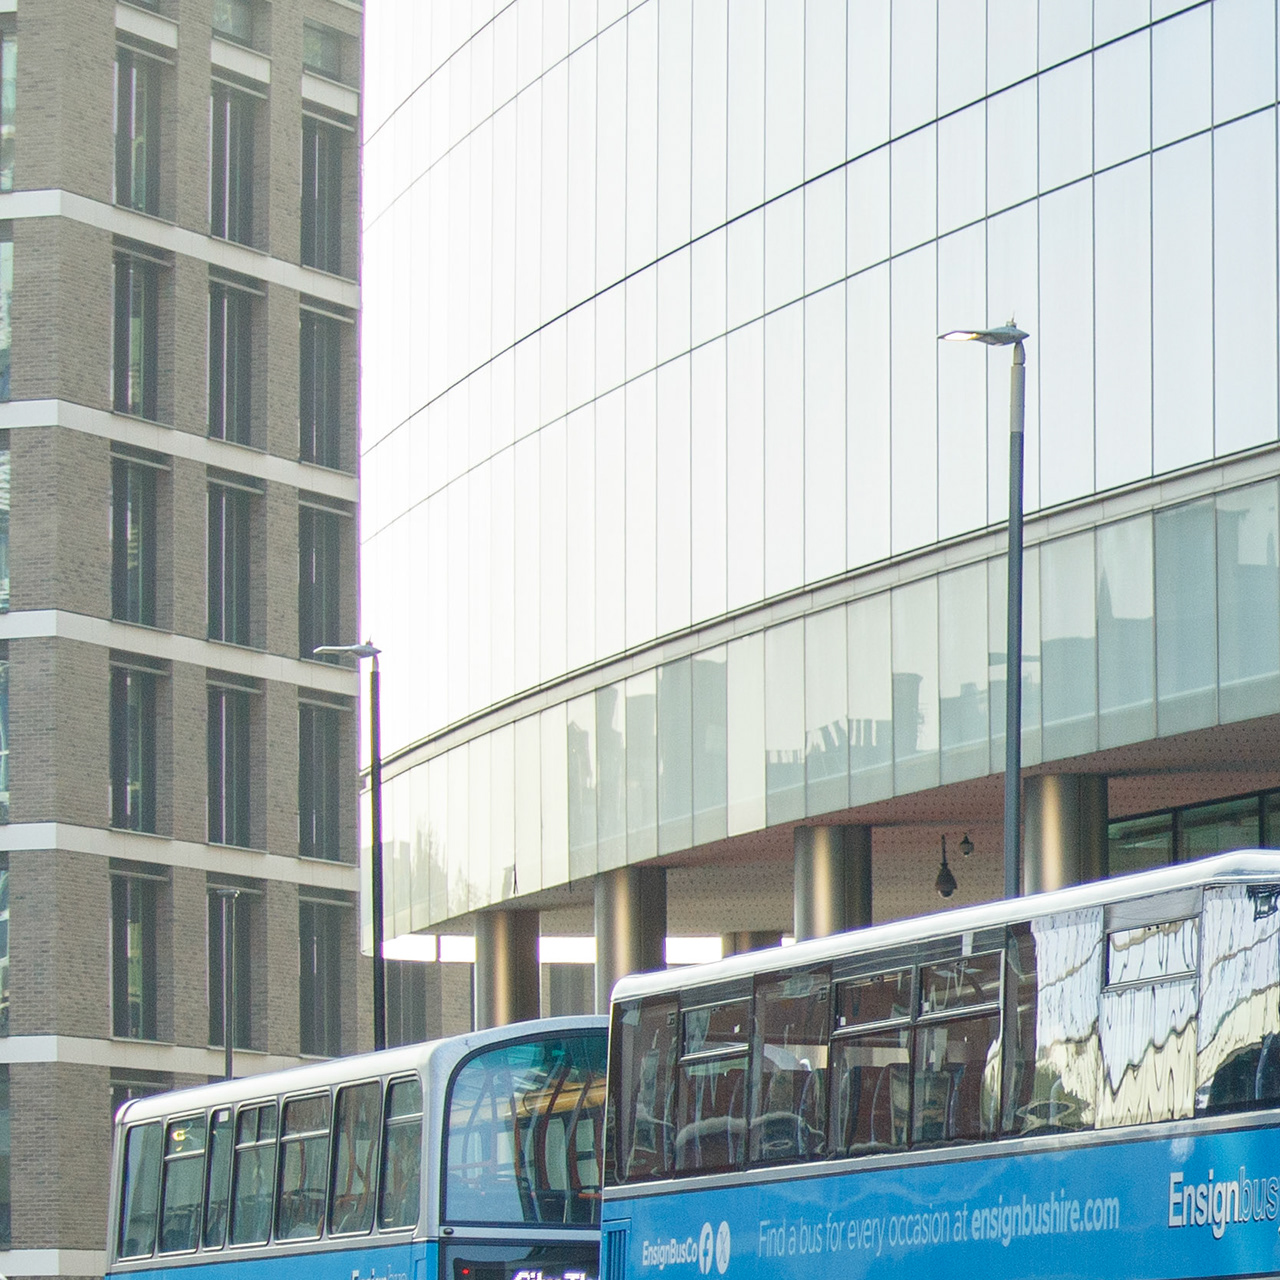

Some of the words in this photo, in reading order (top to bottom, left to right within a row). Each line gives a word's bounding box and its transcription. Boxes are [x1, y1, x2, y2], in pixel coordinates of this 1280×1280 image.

[759, 1219, 786, 1257] Find
[789, 1225, 797, 1256] a
[801, 1216, 823, 1254] bus
[826, 1213, 845, 1252] for
[847, 1216, 886, 1257] every
[889, 1203, 950, 1247] occasion
[953, 1203, 968, 1242] at
[971, 1188, 1119, 1247] ensignbushire.com
[1168, 1165, 1280, 1239] Ensignbus
[642, 1237, 698, 1270] EnsignBusCo
